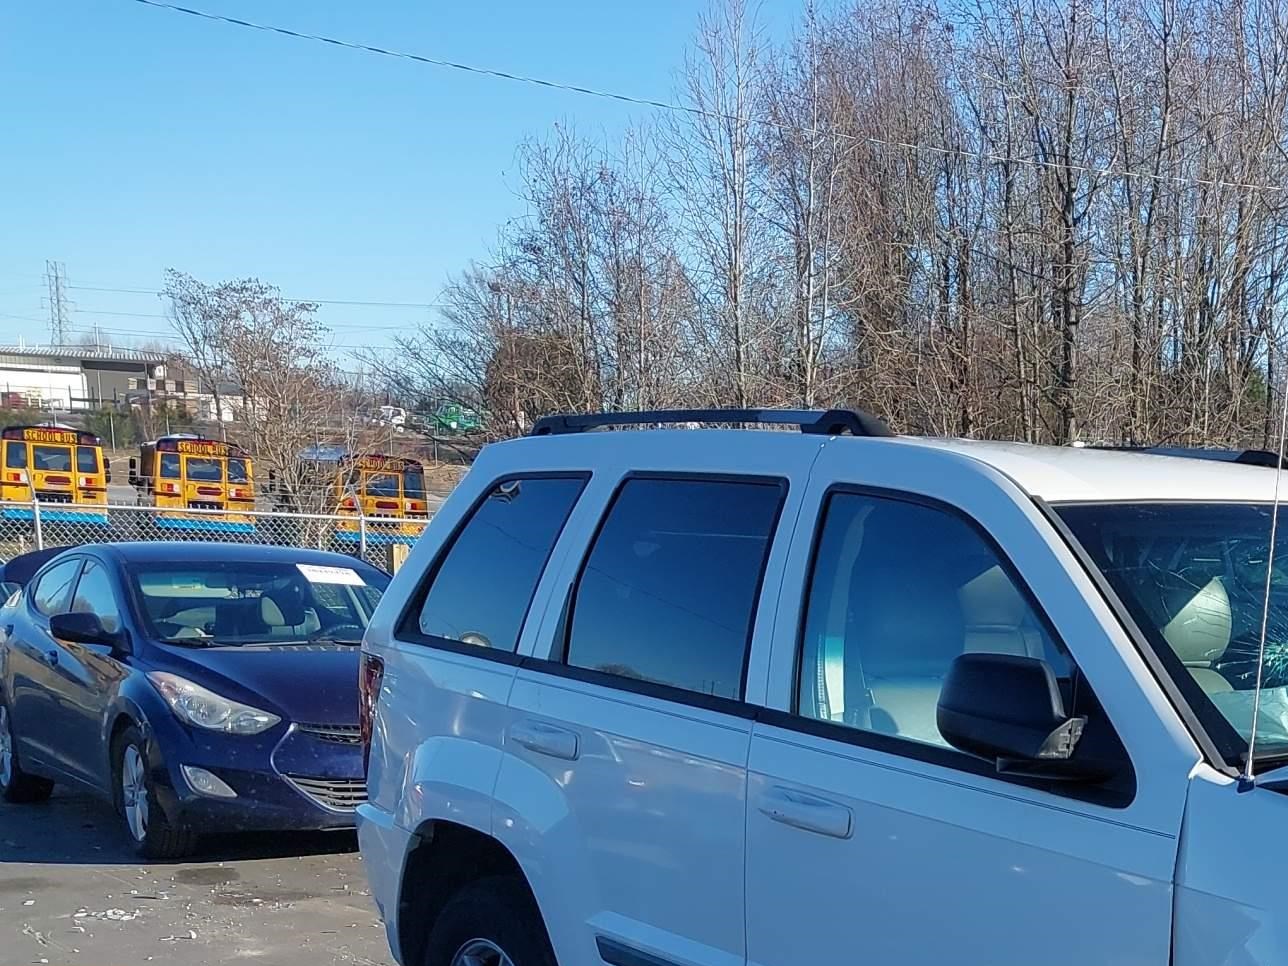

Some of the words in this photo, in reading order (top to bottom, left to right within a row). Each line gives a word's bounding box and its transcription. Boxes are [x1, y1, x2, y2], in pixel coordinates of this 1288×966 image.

[26, 430, 58, 443] SCHOOL
[60, 432, 76, 443] BUS
[180, 441, 209, 454] SCHOOL
[212, 444, 228, 456] BUS
